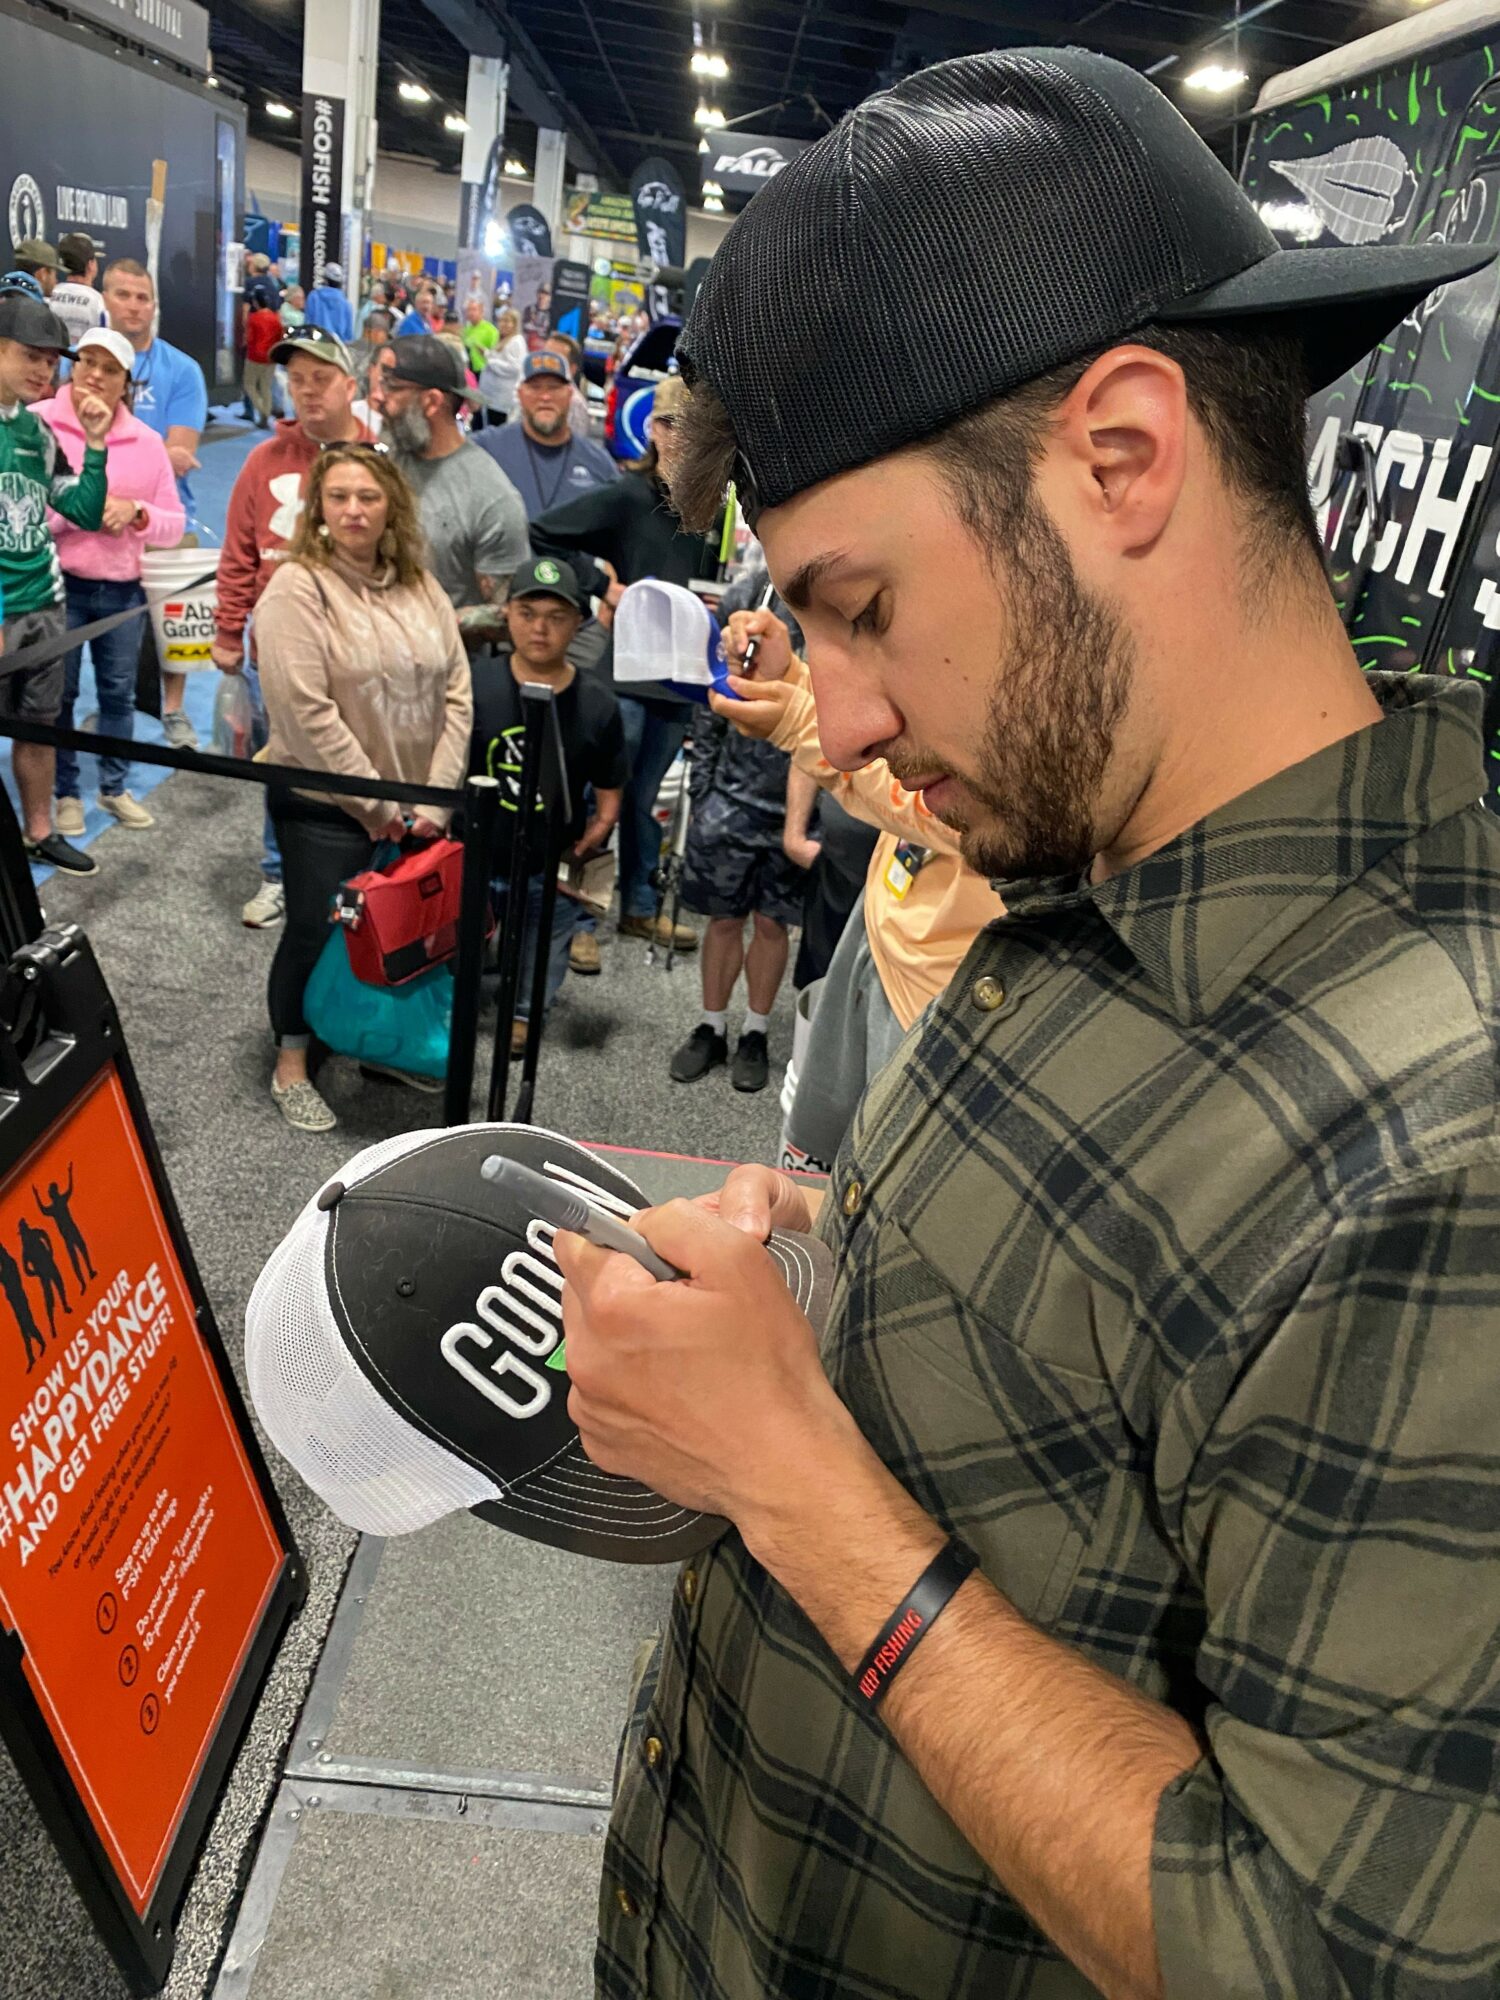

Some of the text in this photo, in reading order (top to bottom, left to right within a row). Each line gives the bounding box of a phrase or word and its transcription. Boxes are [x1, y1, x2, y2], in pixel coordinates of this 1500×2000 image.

[312, 98, 333, 205] #GOFISH
[185, 603, 214, 621] Ab
[11, 1270, 131, 1451] SHOW US YOUR
[20, 1304, 173, 1566] AND GET FREE STUFF!
[859, 1608, 923, 1700] KEEP FISHING
